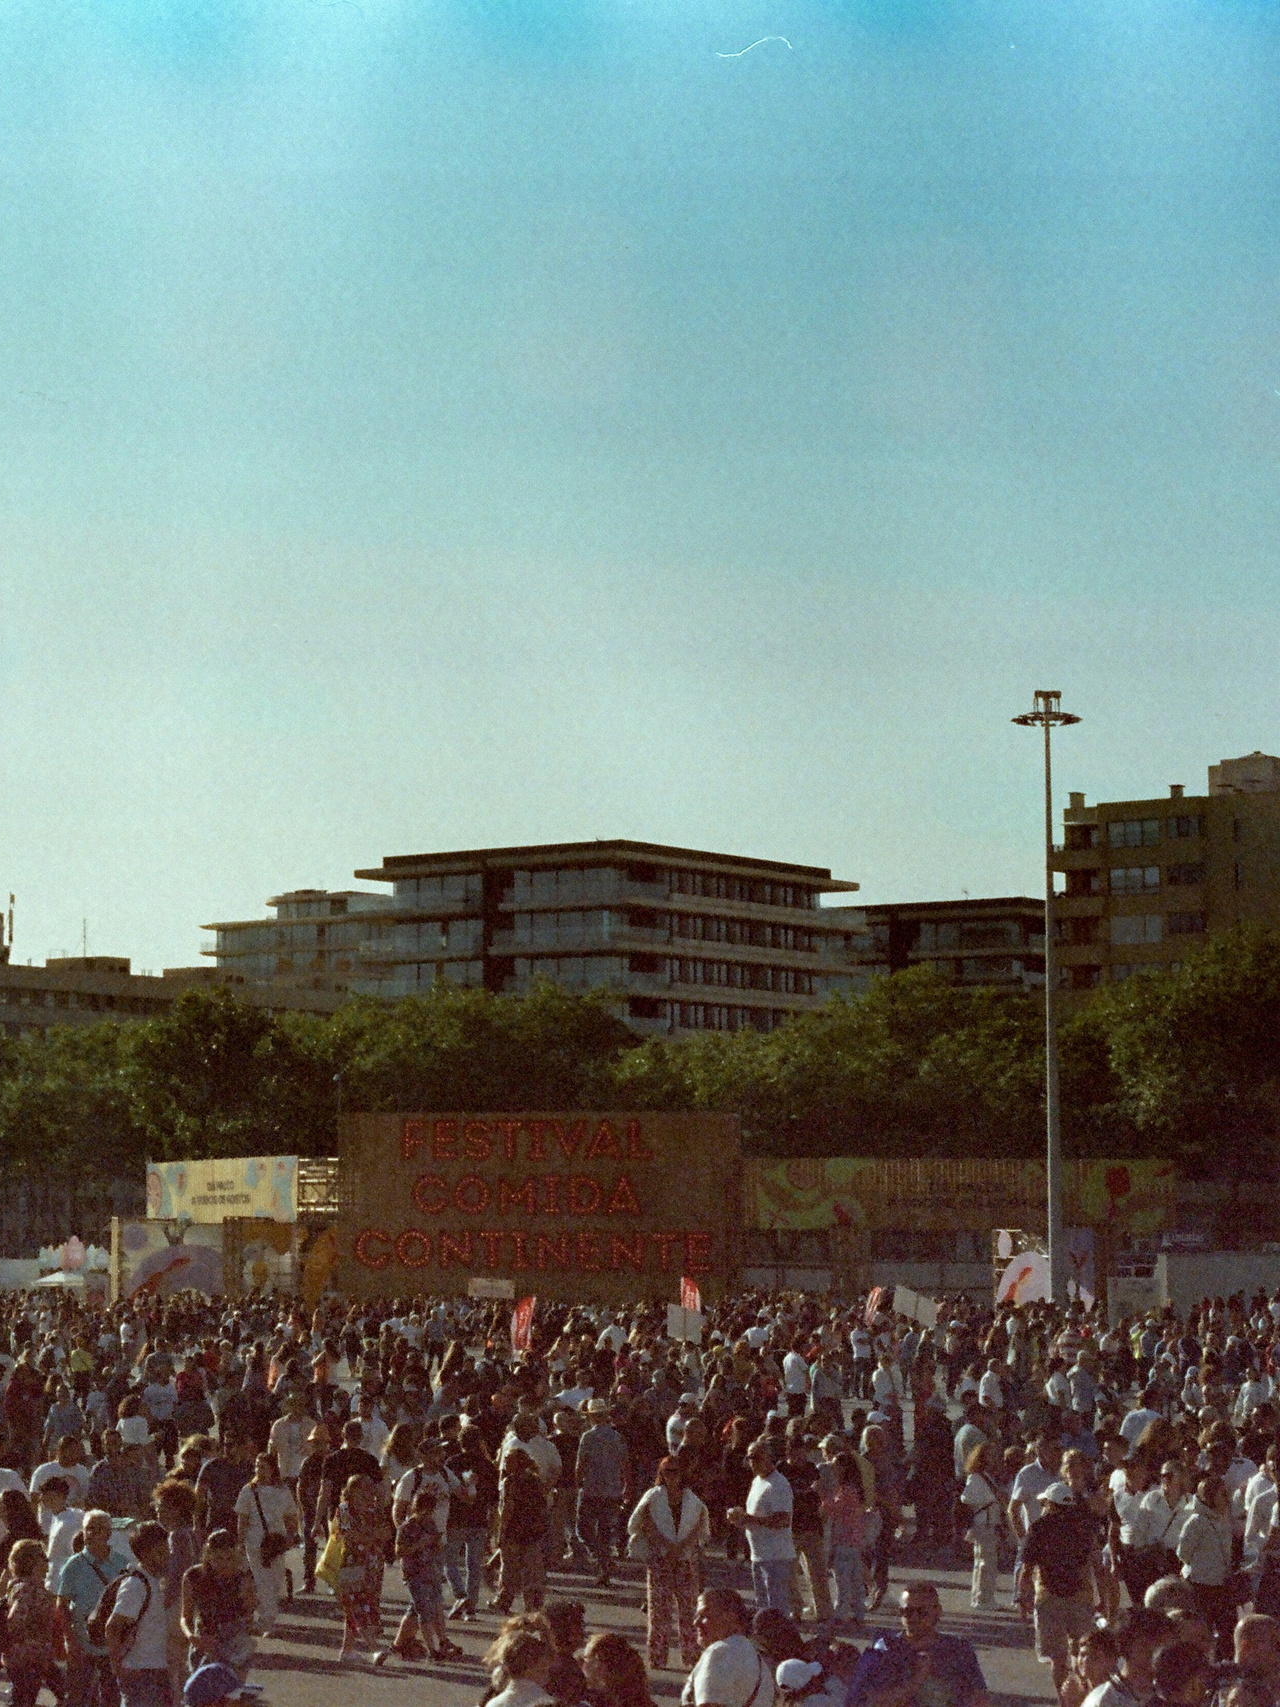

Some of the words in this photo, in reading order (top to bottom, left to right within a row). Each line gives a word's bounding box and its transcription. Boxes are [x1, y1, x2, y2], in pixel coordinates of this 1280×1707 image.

[400, 1118, 655, 1162] FESTIVAL
[411, 1174, 642, 1216] COMIDA
[354, 1228, 714, 1274] CONTINENTE
